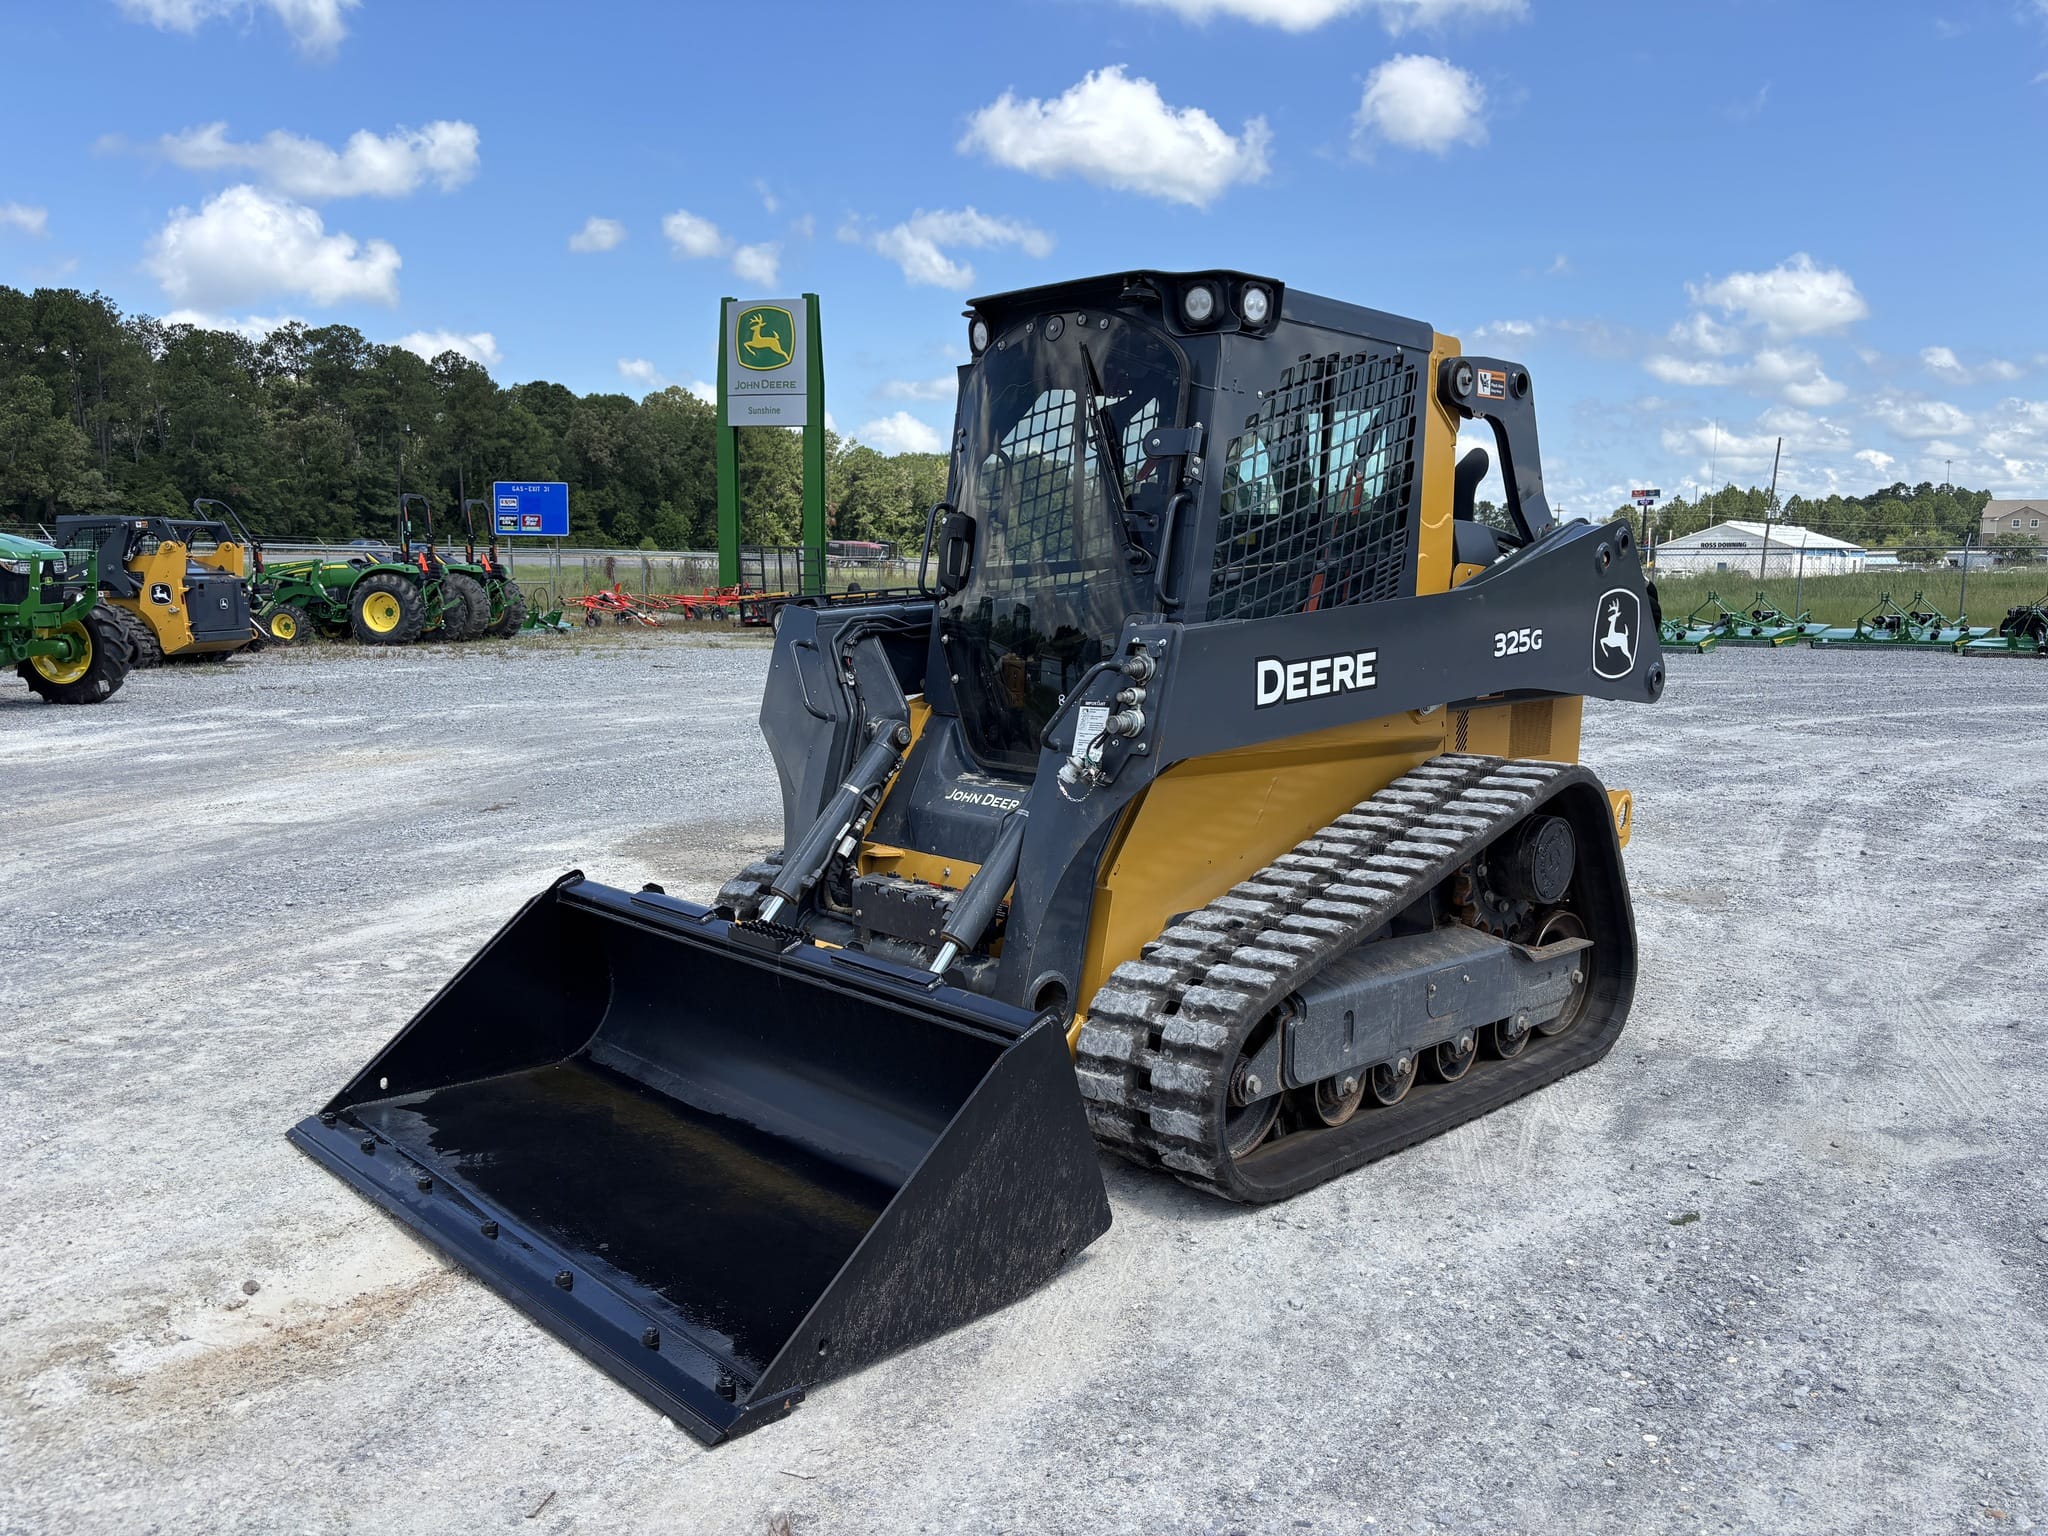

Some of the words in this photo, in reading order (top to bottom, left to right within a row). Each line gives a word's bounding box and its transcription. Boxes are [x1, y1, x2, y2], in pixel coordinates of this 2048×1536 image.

[735, 380, 760, 390] JOHN
[762, 379, 797, 389] DEERE
[748, 406, 781, 415] Sunshine
[1494, 628, 1543, 657] 325G
[1257, 651, 1377, 706] DEERE
[945, 788, 983, 805] JOHN
[982, 793, 1020, 810] DEER
